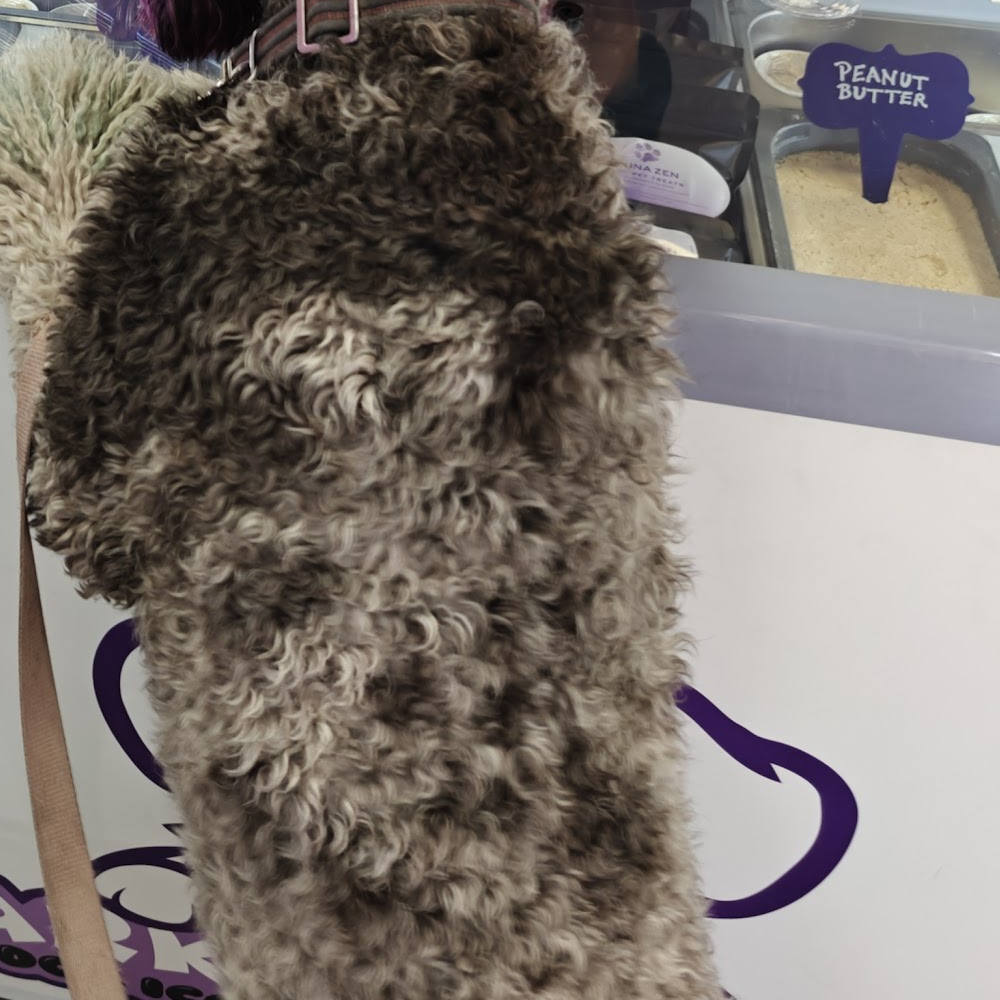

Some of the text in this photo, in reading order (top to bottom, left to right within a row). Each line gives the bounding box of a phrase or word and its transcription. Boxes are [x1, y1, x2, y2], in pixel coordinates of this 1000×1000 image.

[833, 60, 930, 91] PEANUT
[836, 83, 929, 109] BUTTER
[629, 162, 680, 179] INA ZEN
[632, 171, 685, 188] PET TREATS
